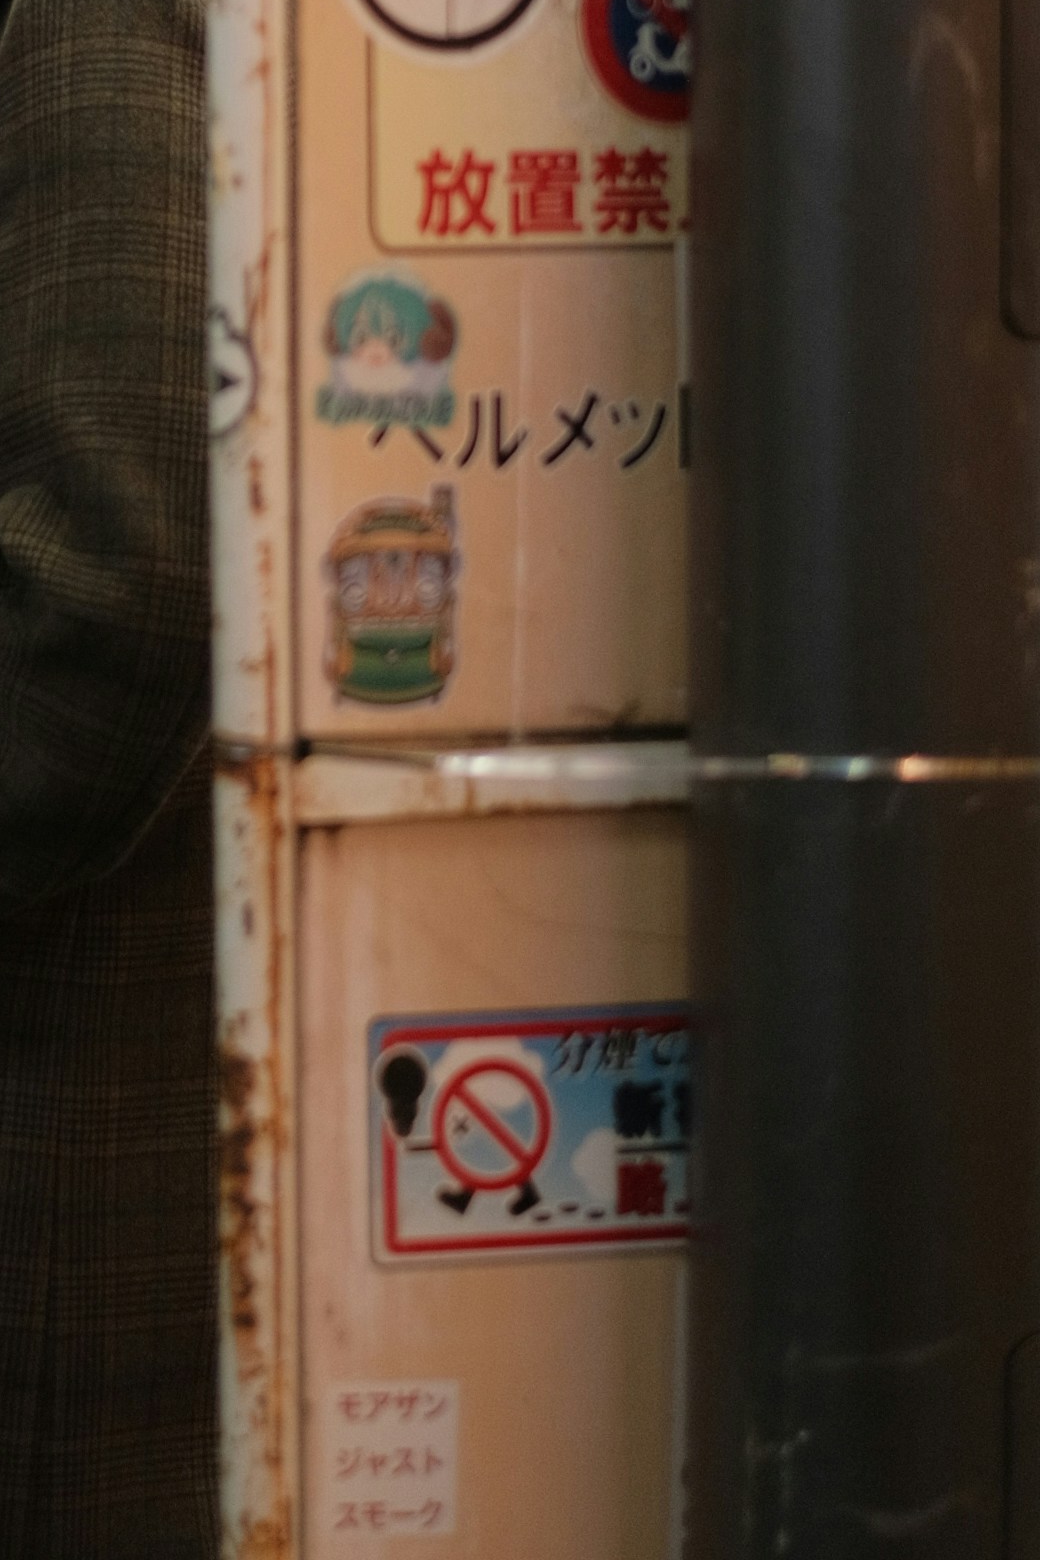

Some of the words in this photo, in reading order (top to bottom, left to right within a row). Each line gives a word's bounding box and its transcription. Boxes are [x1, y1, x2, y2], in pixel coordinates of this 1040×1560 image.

[418, 146, 690, 236] 放置禁
[335, 1500, 444, 1530] スモーク
